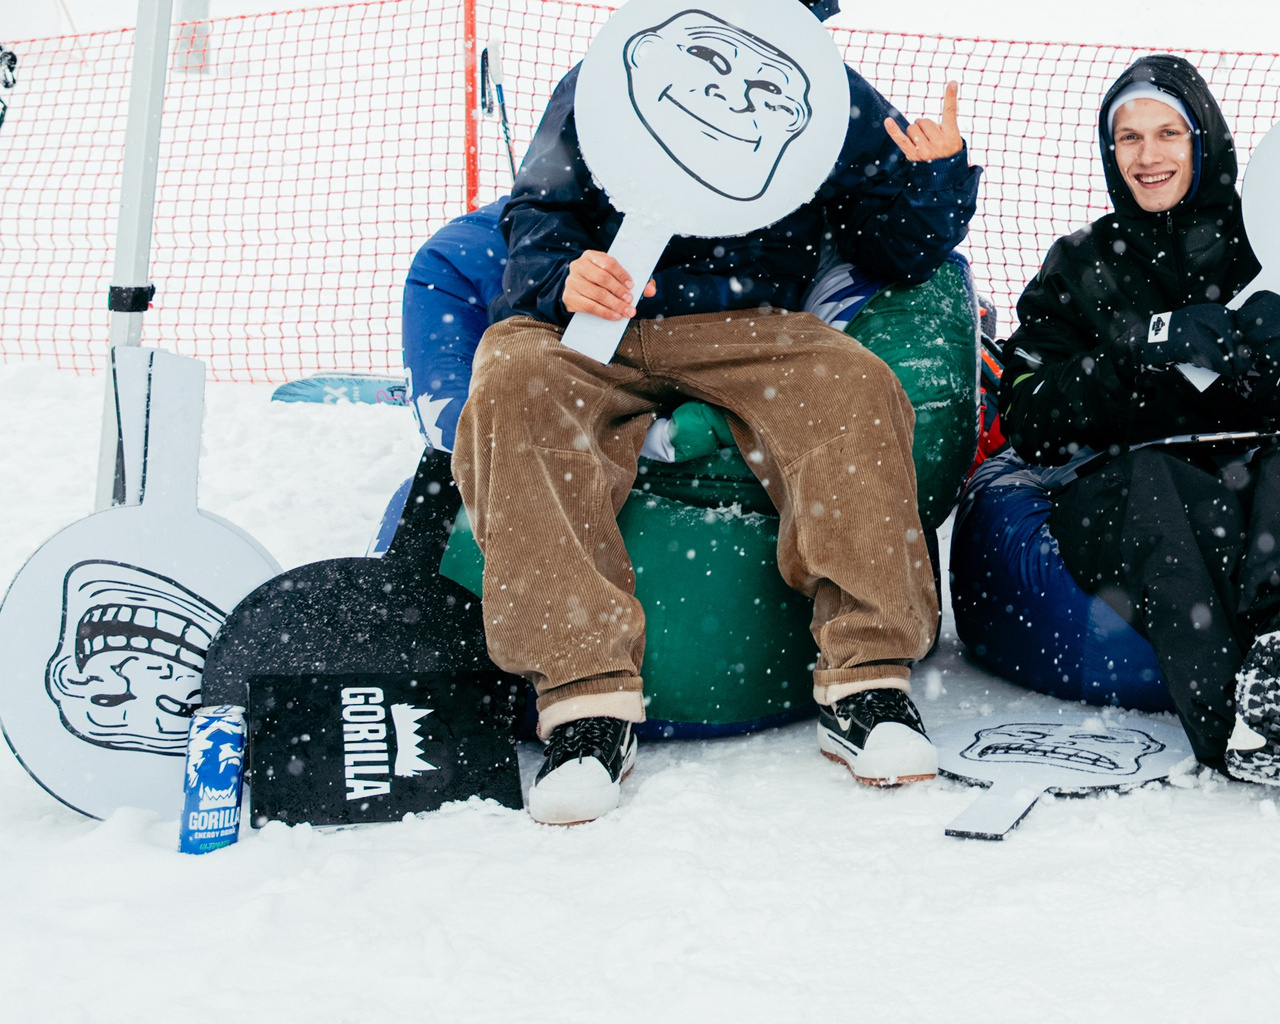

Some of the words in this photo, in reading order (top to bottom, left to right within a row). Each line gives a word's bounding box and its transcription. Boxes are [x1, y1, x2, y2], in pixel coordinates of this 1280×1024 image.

[341, 687, 390, 800] GORILLA
[189, 806, 240, 830] GORILLA
[194, 831, 220, 839] ENERGY
